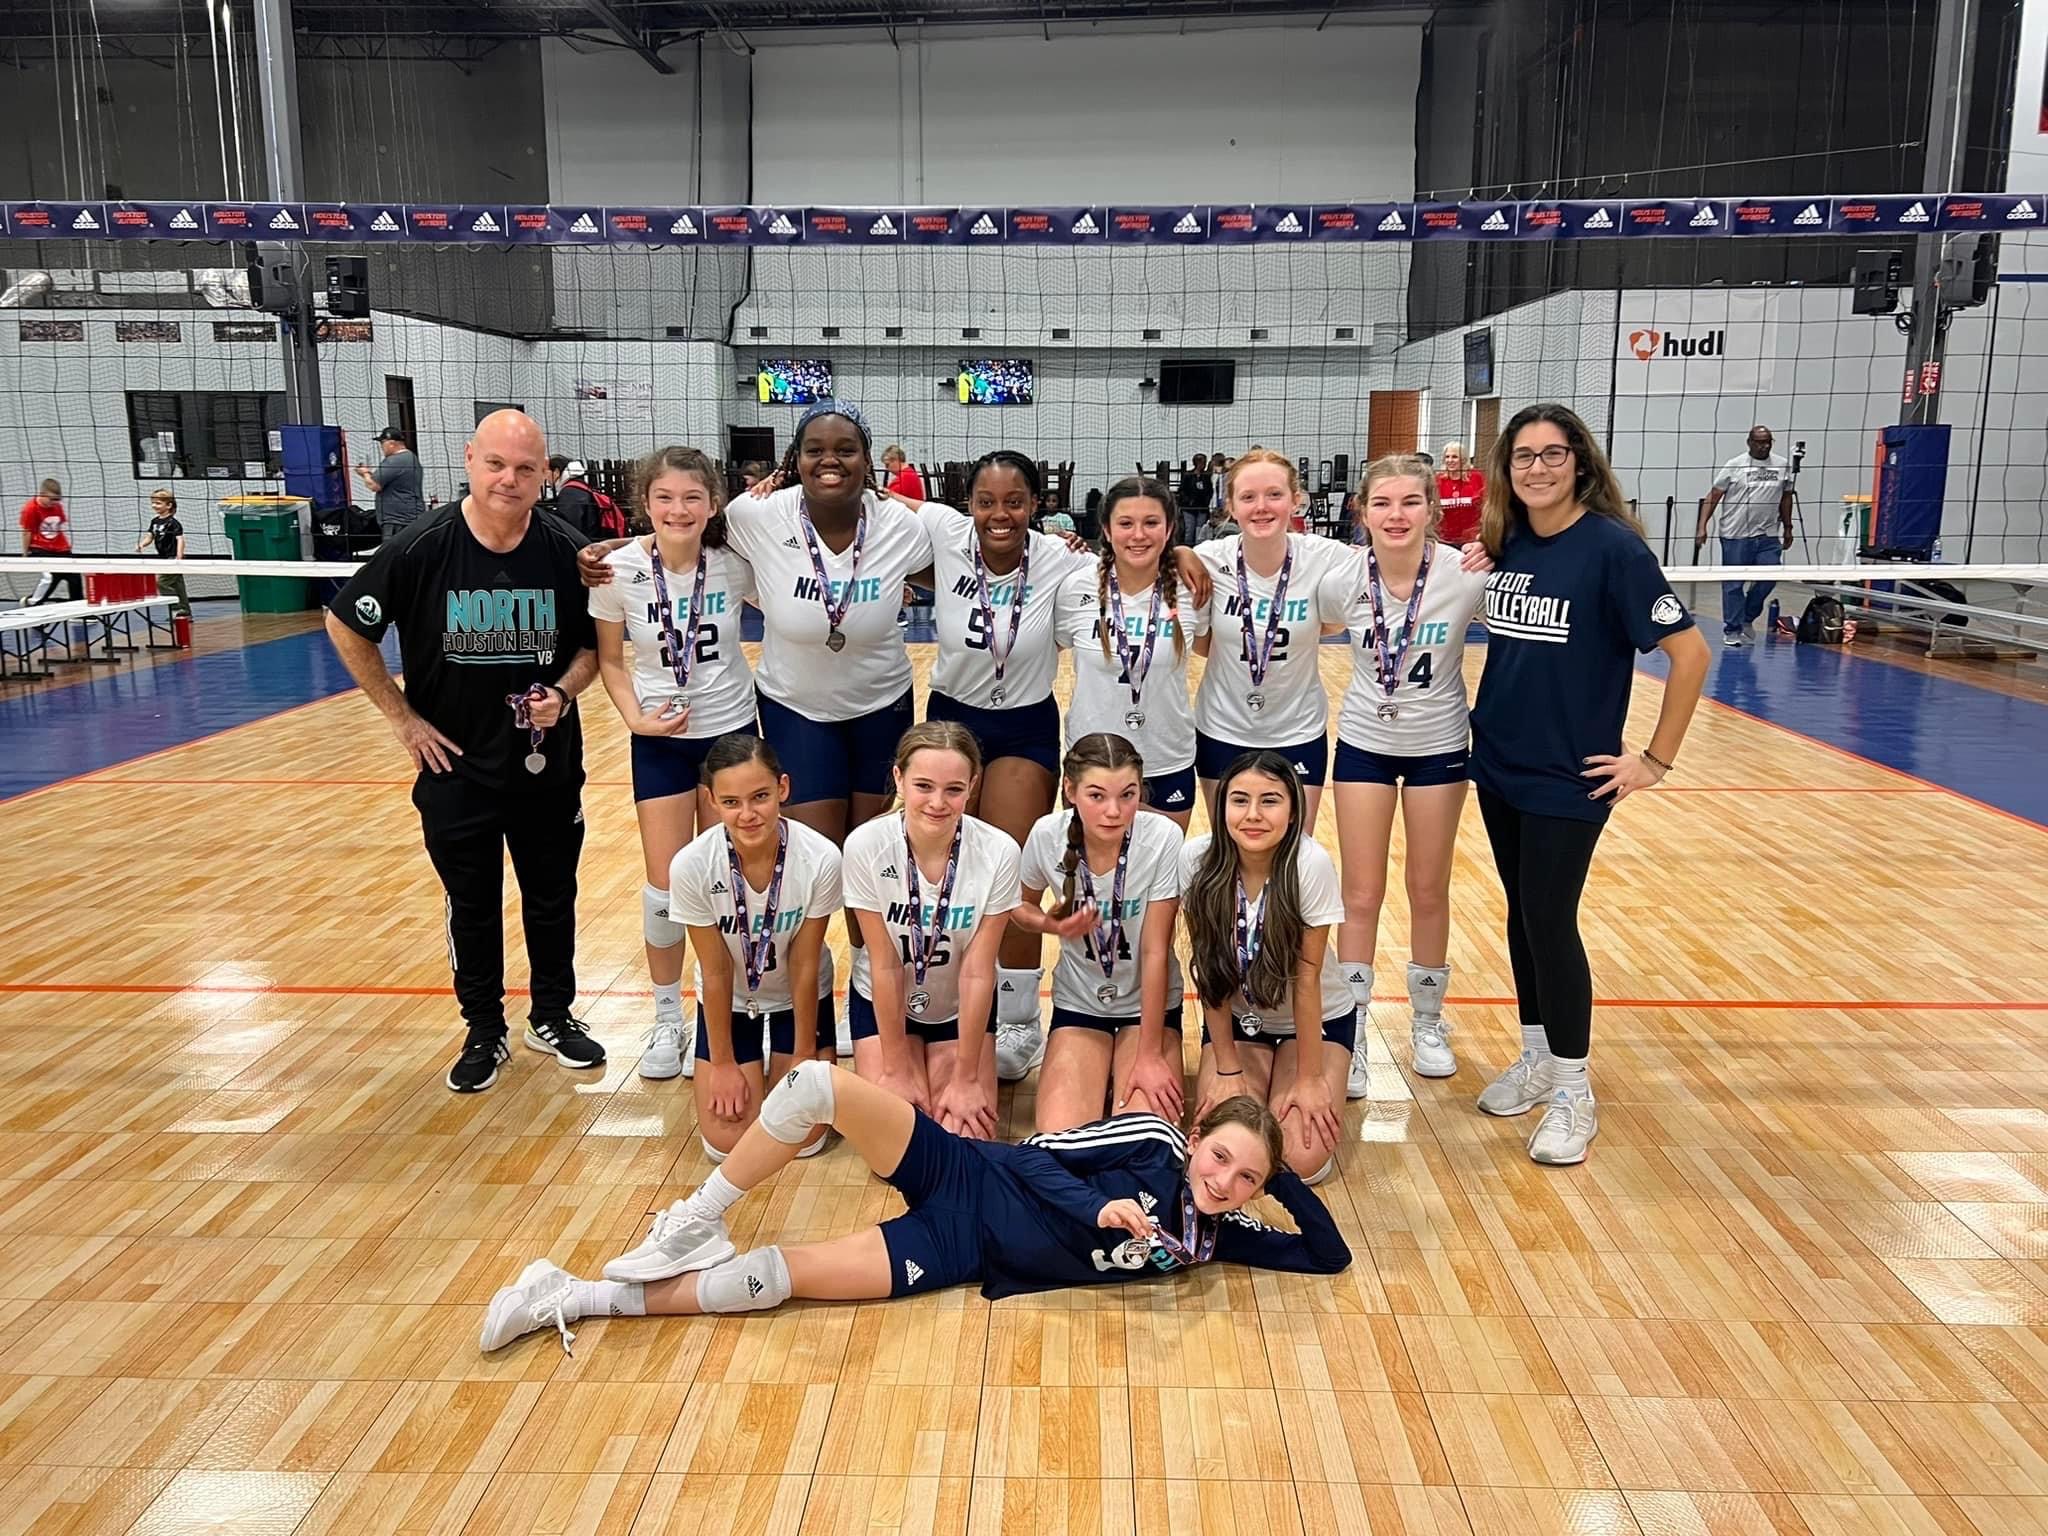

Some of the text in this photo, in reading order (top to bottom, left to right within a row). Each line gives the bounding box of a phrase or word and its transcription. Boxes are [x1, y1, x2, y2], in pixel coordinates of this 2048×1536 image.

[1899, 215, 1930, 223] adidas
[2006, 212, 2037, 220] adidas
[72, 221, 100, 229] adidas
[169, 221, 199, 229] adidas
[269, 221, 300, 229] adidas
[1583, 221, 1613, 229] adidas
[1689, 219, 1719, 227] adidas
[1793, 217, 1823, 225] adidas
[370, 223, 400, 231] adidas
[472, 224, 500, 232] adidas
[570, 226, 599, 234] adidas
[670, 226, 698, 234] adidas
[768, 227, 797, 235] adidas
[869, 227, 898, 235] adidas
[970, 227, 998, 235] adidas
[1071, 226, 1100, 234] adidas
[1173, 225, 1202, 233] adidas
[1275, 225, 1303, 233] adidas
[1377, 223, 1406, 231] adidas
[1480, 223, 1509, 231] adidas
[1663, 330, 1725, 357] hudl
[1497, 572, 1535, 595] ELITE
[677, 591, 726, 620] EITE
[1485, 589, 1571, 629] OLLEYBALL
[446, 589, 556, 633] NORTH
[442, 631, 517, 653] HOUSTON
[657, 623, 720, 668] 22
[537, 650, 556, 666] VB
